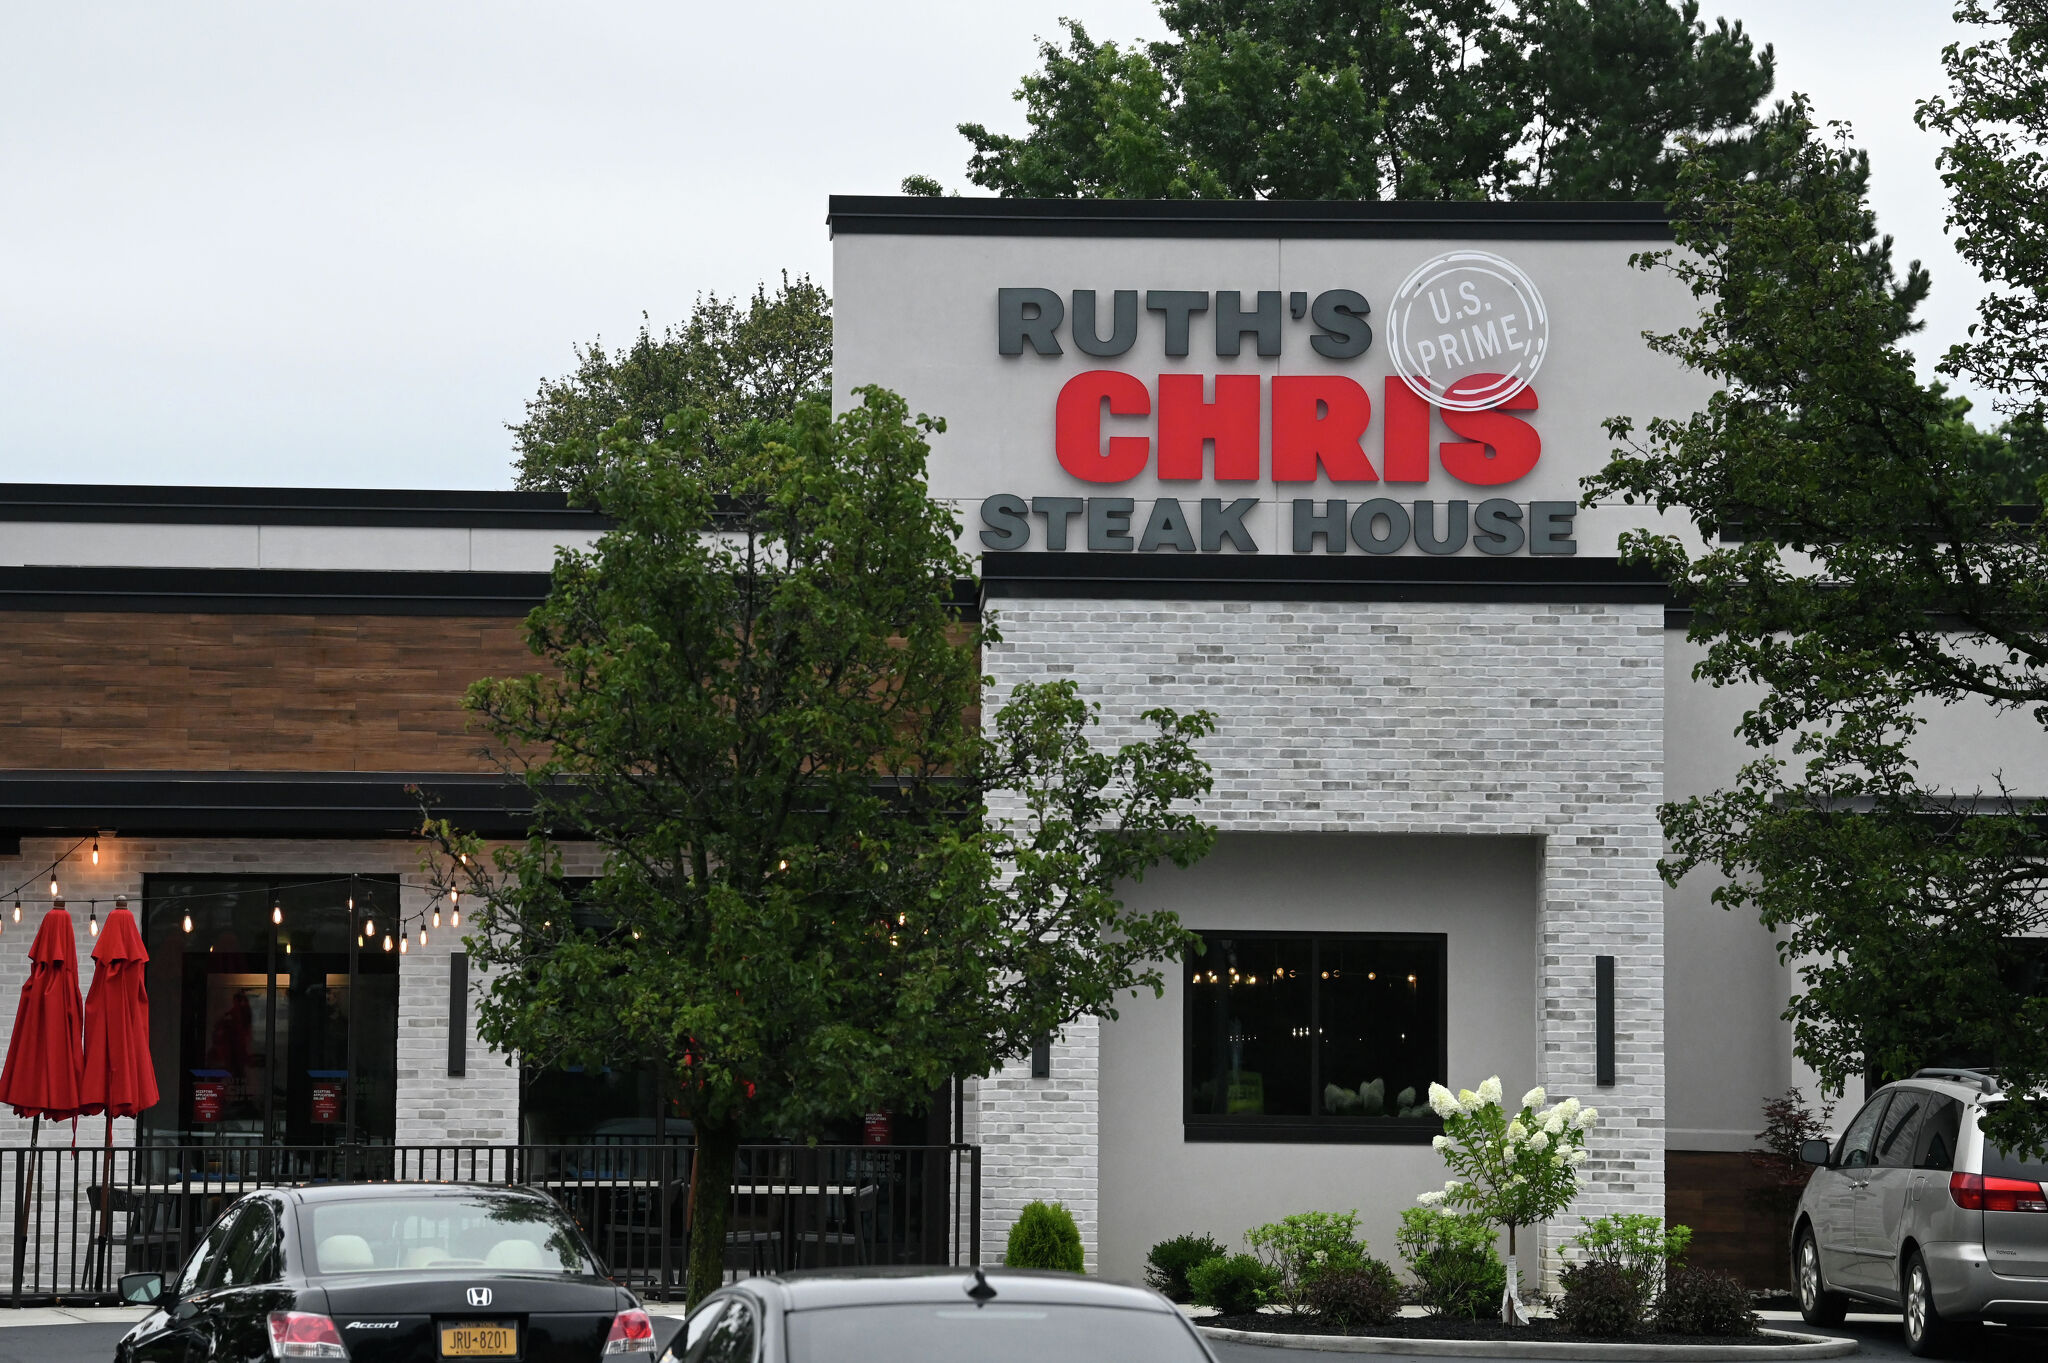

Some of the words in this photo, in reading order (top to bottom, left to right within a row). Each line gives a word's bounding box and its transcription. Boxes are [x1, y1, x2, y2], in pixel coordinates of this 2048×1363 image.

[998, 287, 1373, 360] RUTH'S
[1428, 281, 1492, 324] U.S.
[1417, 313, 1524, 377] PRIME
[1055, 369, 1542, 486] CHRIS
[979, 494, 1261, 553] STEAK
[1292, 497, 1578, 556] HOUSE
[345, 1321, 399, 1329] Accord
